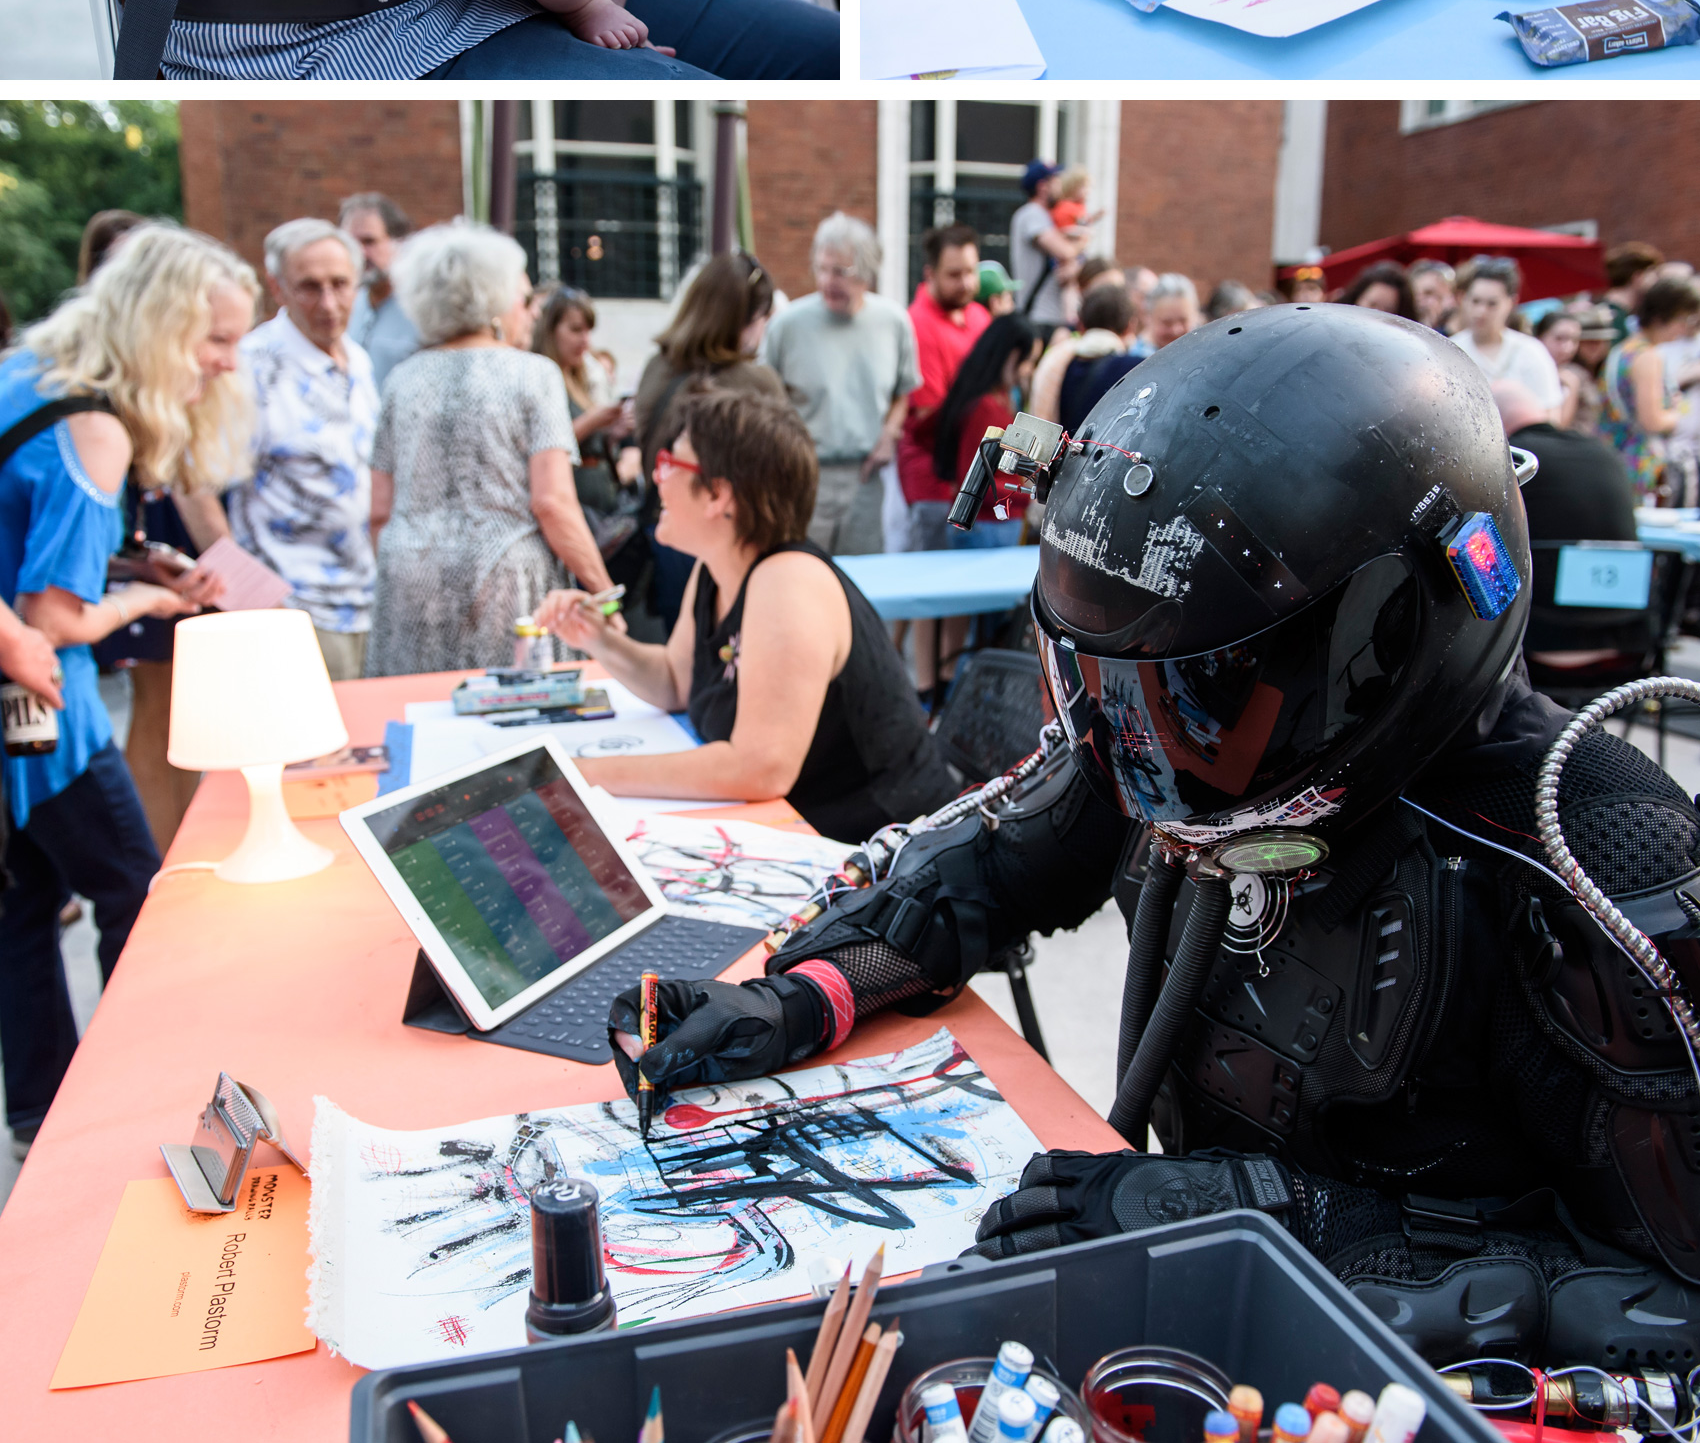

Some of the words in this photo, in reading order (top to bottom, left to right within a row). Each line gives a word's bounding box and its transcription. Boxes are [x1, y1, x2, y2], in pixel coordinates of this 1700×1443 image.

[1577, 15, 1618, 29] Bar
[1610, 6, 1650, 22] Fig
[257, 1174, 278, 1220] MONSTER
[1252, 1161, 1271, 1180] FIRM
[1262, 1181, 1279, 1202] GRIP
[216, 1232, 247, 1279] Robert
[171, 1271, 192, 1318] plastorm.com
[199, 1282, 236, 1351] Plastorm
